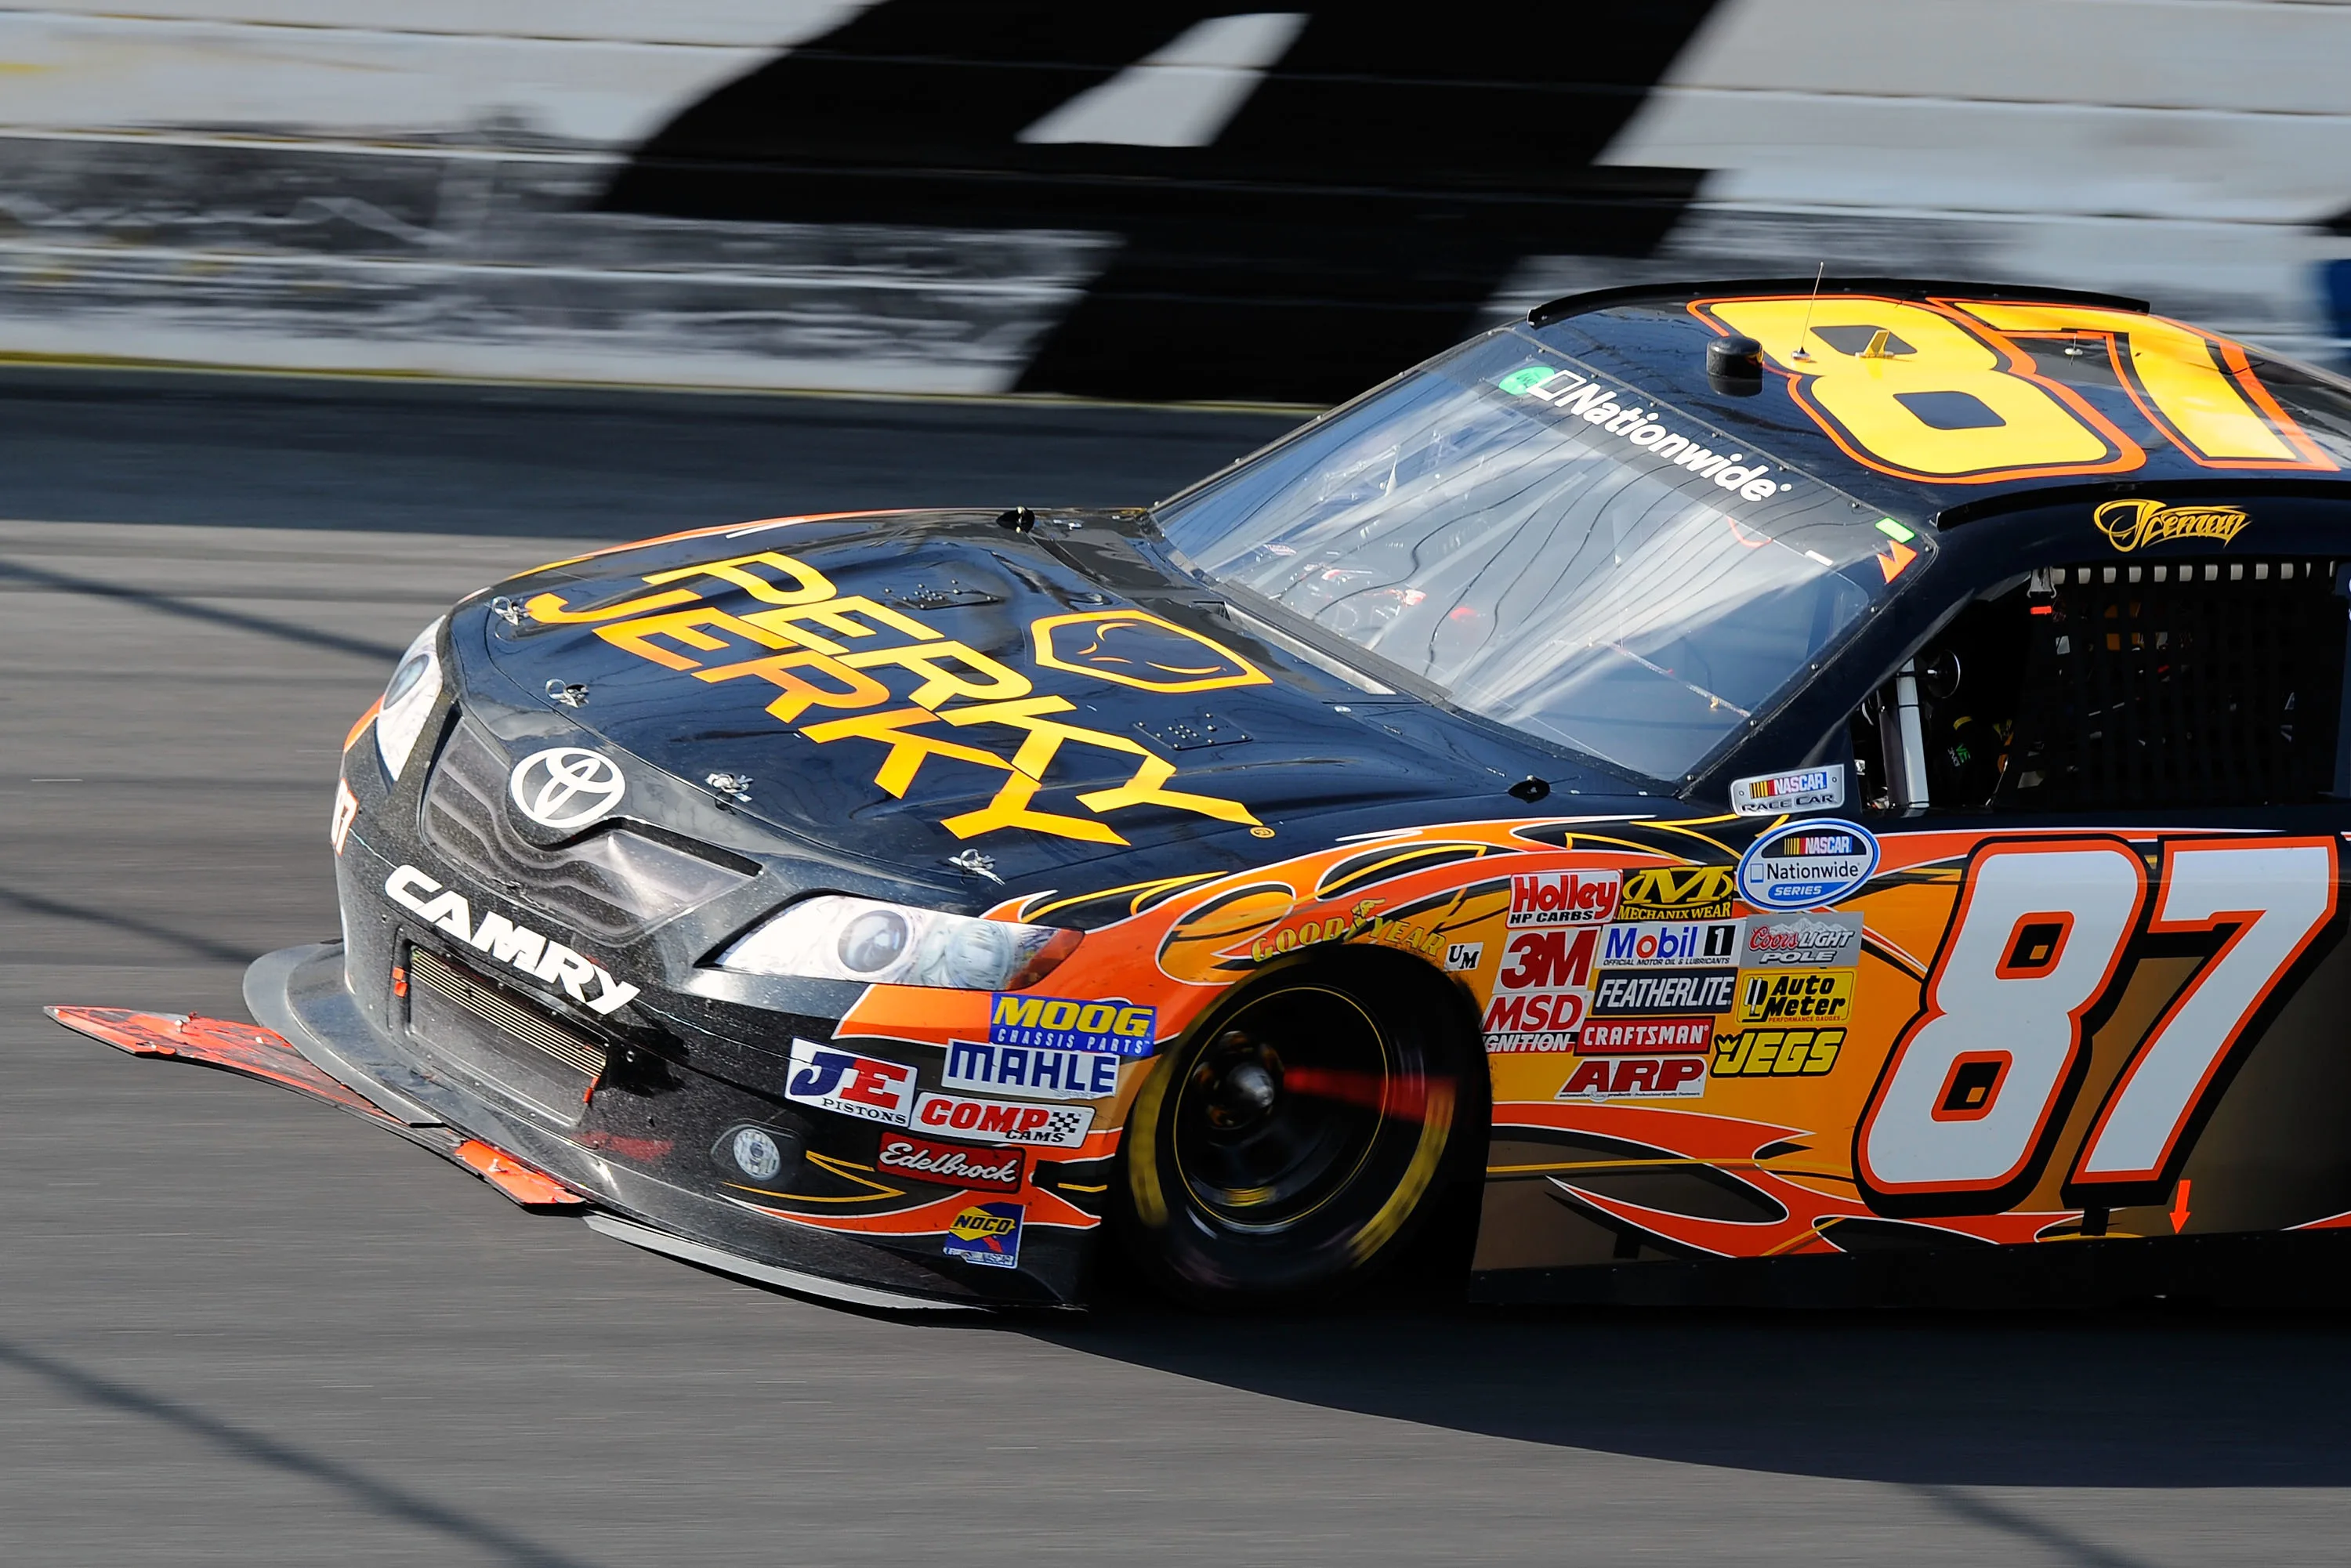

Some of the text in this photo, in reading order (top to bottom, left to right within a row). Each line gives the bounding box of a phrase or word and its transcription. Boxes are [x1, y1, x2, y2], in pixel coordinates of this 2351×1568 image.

[1687, 294, 2340, 484] 87
[1554, 382, 1778, 502] Nationwide
[642, 551, 1266, 827] PERKY
[524, 589, 1132, 846] JERKY
[1773, 771, 1828, 796] NASCAR
[1741, 793, 1834, 813] RACE CAR
[1805, 836, 1853, 854] NASCAR
[1766, 862, 1859, 880] Nationwide
[1512, 875, 1617, 920] Holley
[1773, 885, 1822, 896] SERIES
[1509, 910, 1595, 925] HP CARBS
[1616, 901, 1731, 921] MECHANIX WEAR
[384, 864, 640, 1015] CAMRY
[1604, 925, 1726, 959] Mobil 1
[1748, 925, 1856, 951] Coors LIGHT
[1449, 946, 1480, 969] UM
[1500, 929, 1597, 989] 3M
[1603, 958, 1634, 966] OFFICIAL
[1759, 950, 1837, 965] POLE
[1596, 976, 1733, 1009] FEATHERLITE
[1770, 975, 1835, 996] Auto
[991, 996, 1154, 1037] MOOG
[1483, 994, 1583, 1032] MSD
[1763, 996, 1846, 1017] Meter
[1858, 836, 2339, 1195] 87
[997, 1028, 1144, 1055] CHASSIS PARTS
[1583, 1026, 1704, 1047] CRAFTSMAN
[1713, 1031, 1844, 1074] JEGS
[788, 1050, 910, 1110] JE
[947, 1041, 1118, 1093] MAHLE
[1561, 1059, 1705, 1092] ARP
[821, 1097, 907, 1126] PISTONS
[920, 1097, 1052, 1134] COMP
[1004, 1128, 1067, 1144] CAMS
[878, 1141, 1019, 1183] Edelbrock
